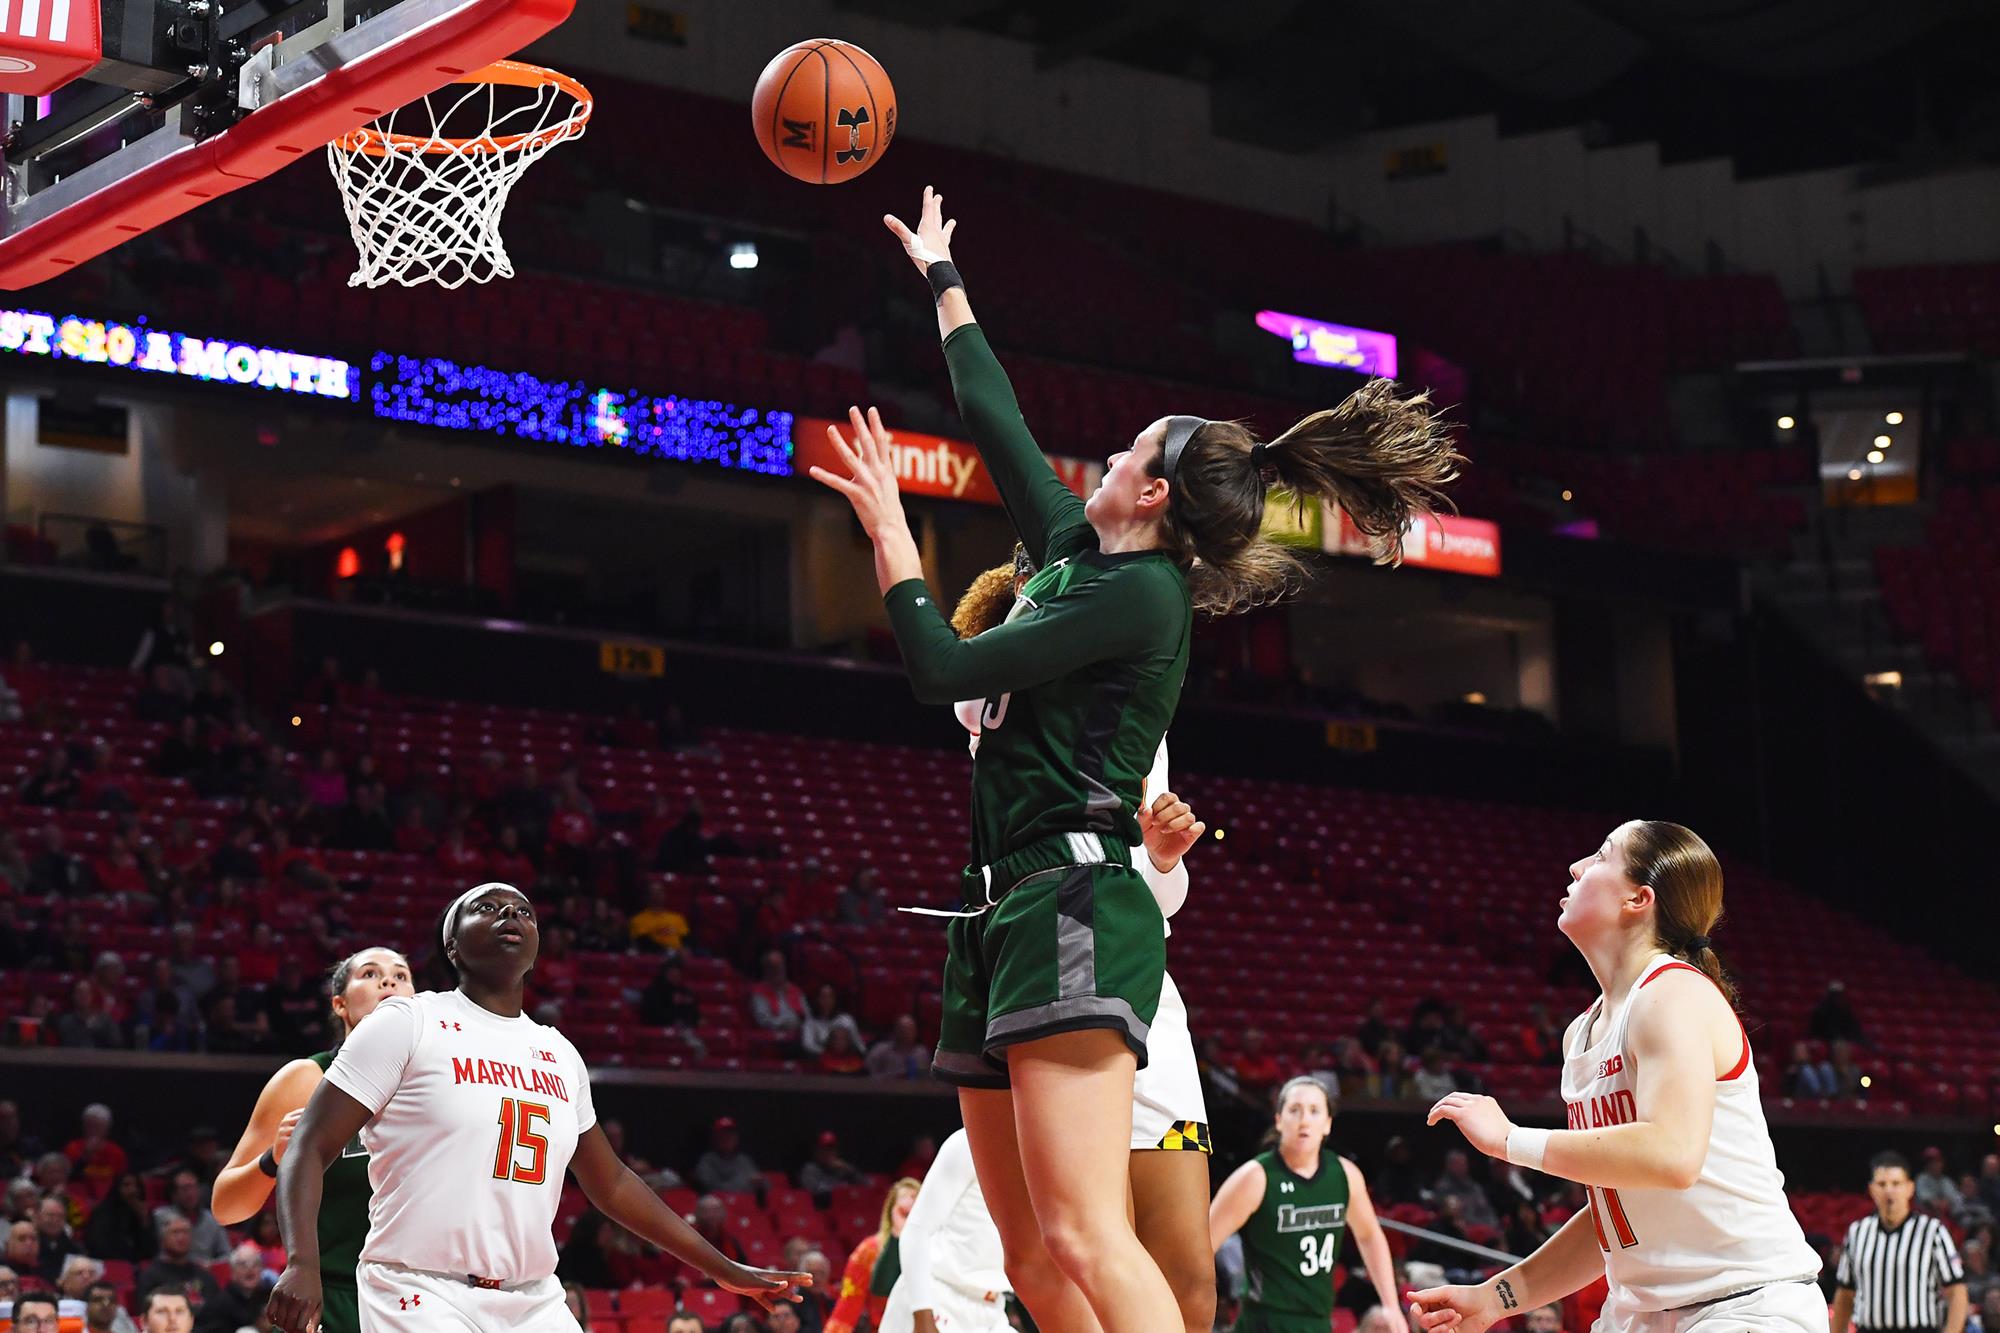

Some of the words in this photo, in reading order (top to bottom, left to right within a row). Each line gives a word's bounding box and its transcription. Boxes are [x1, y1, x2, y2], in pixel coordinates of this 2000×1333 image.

[140, 332, 177, 373] A
[178, 337, 349, 398] MONTH
[452, 1057, 569, 1103] MARYLAND
[493, 1097, 551, 1186] 15
[1300, 1233, 1335, 1277] 34
